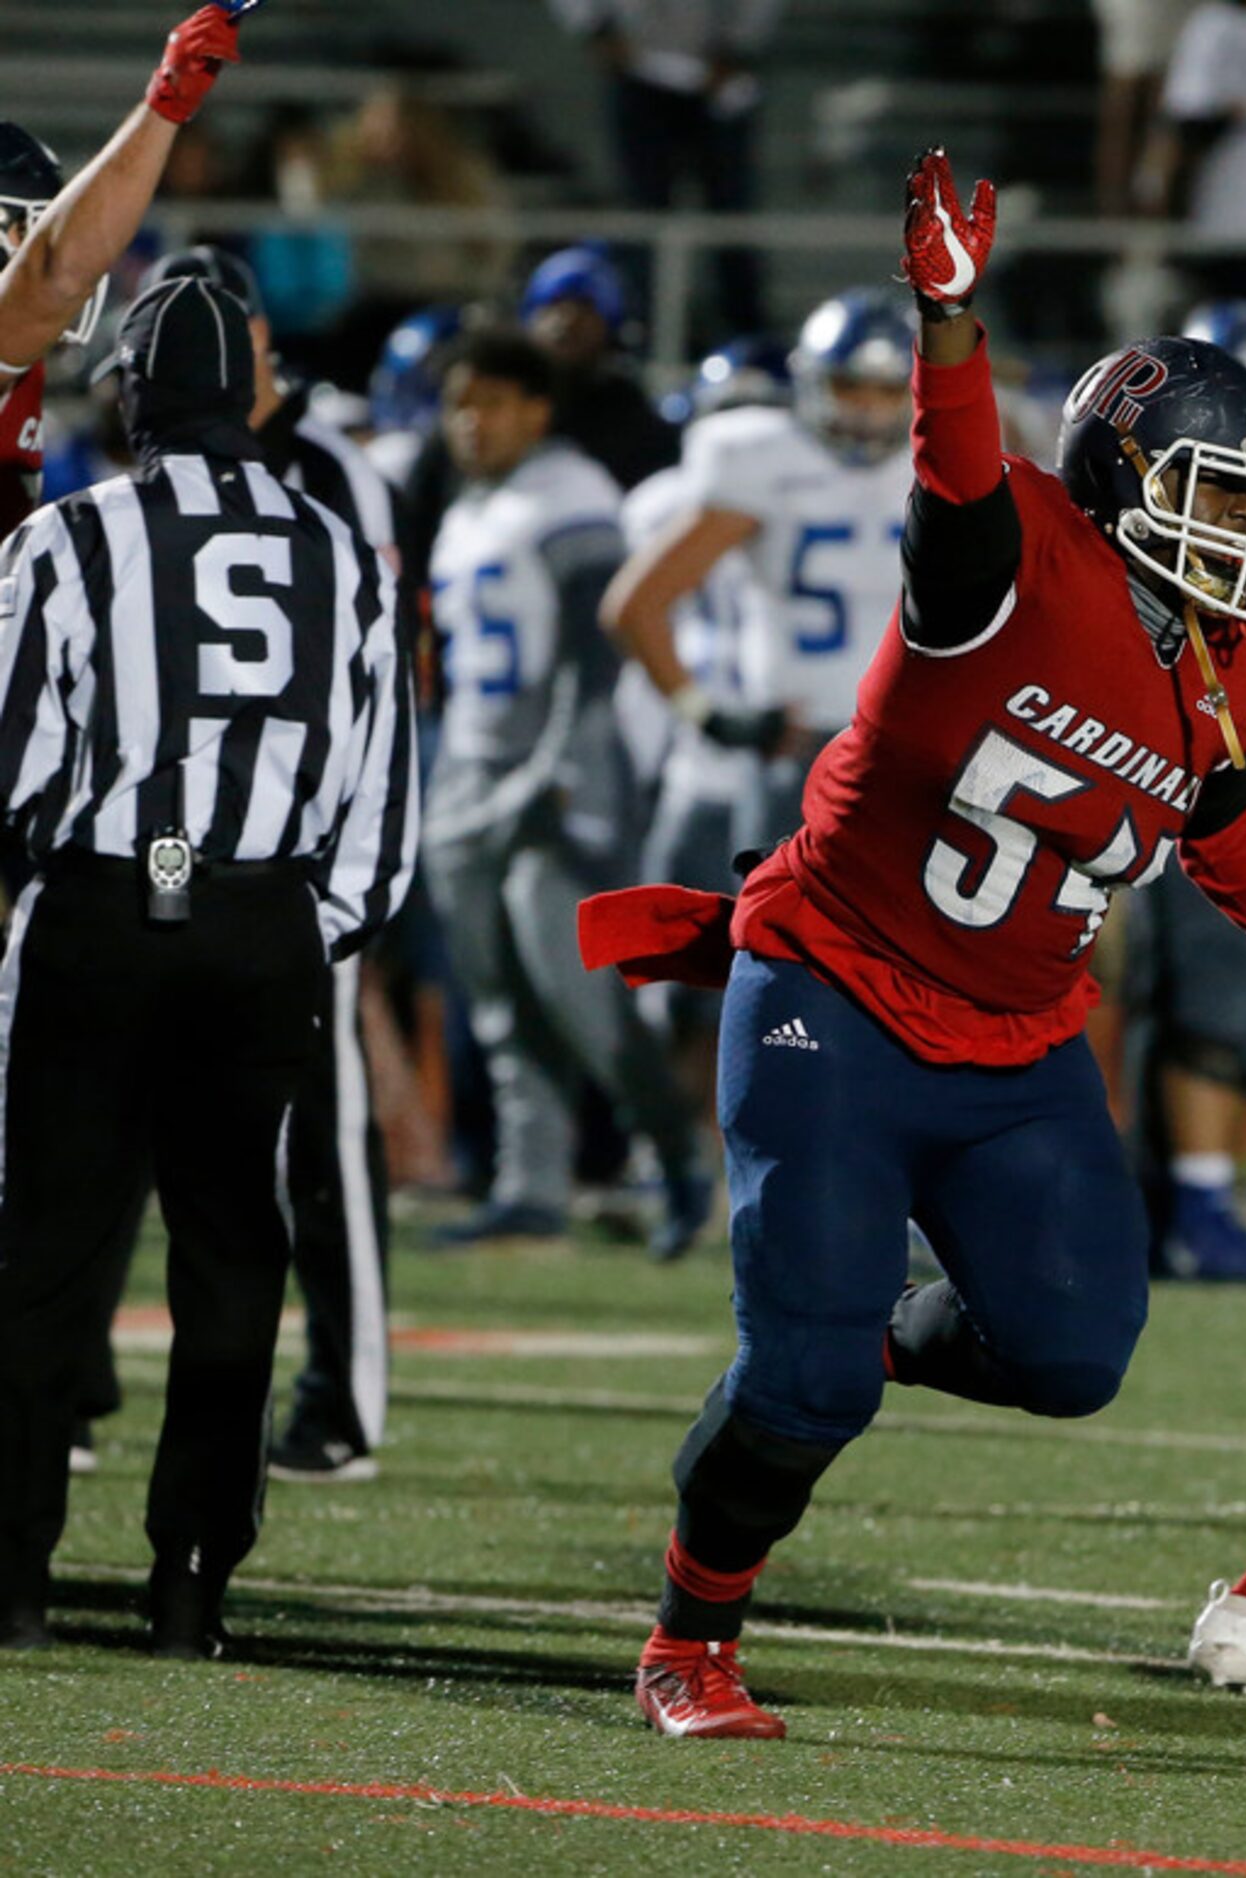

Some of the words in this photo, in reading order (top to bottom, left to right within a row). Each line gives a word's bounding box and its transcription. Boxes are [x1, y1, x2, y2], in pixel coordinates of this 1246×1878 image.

[193, 532, 294, 696] S
[922, 724, 1177, 958] 54
[762, 1034, 819, 1051] adidas
